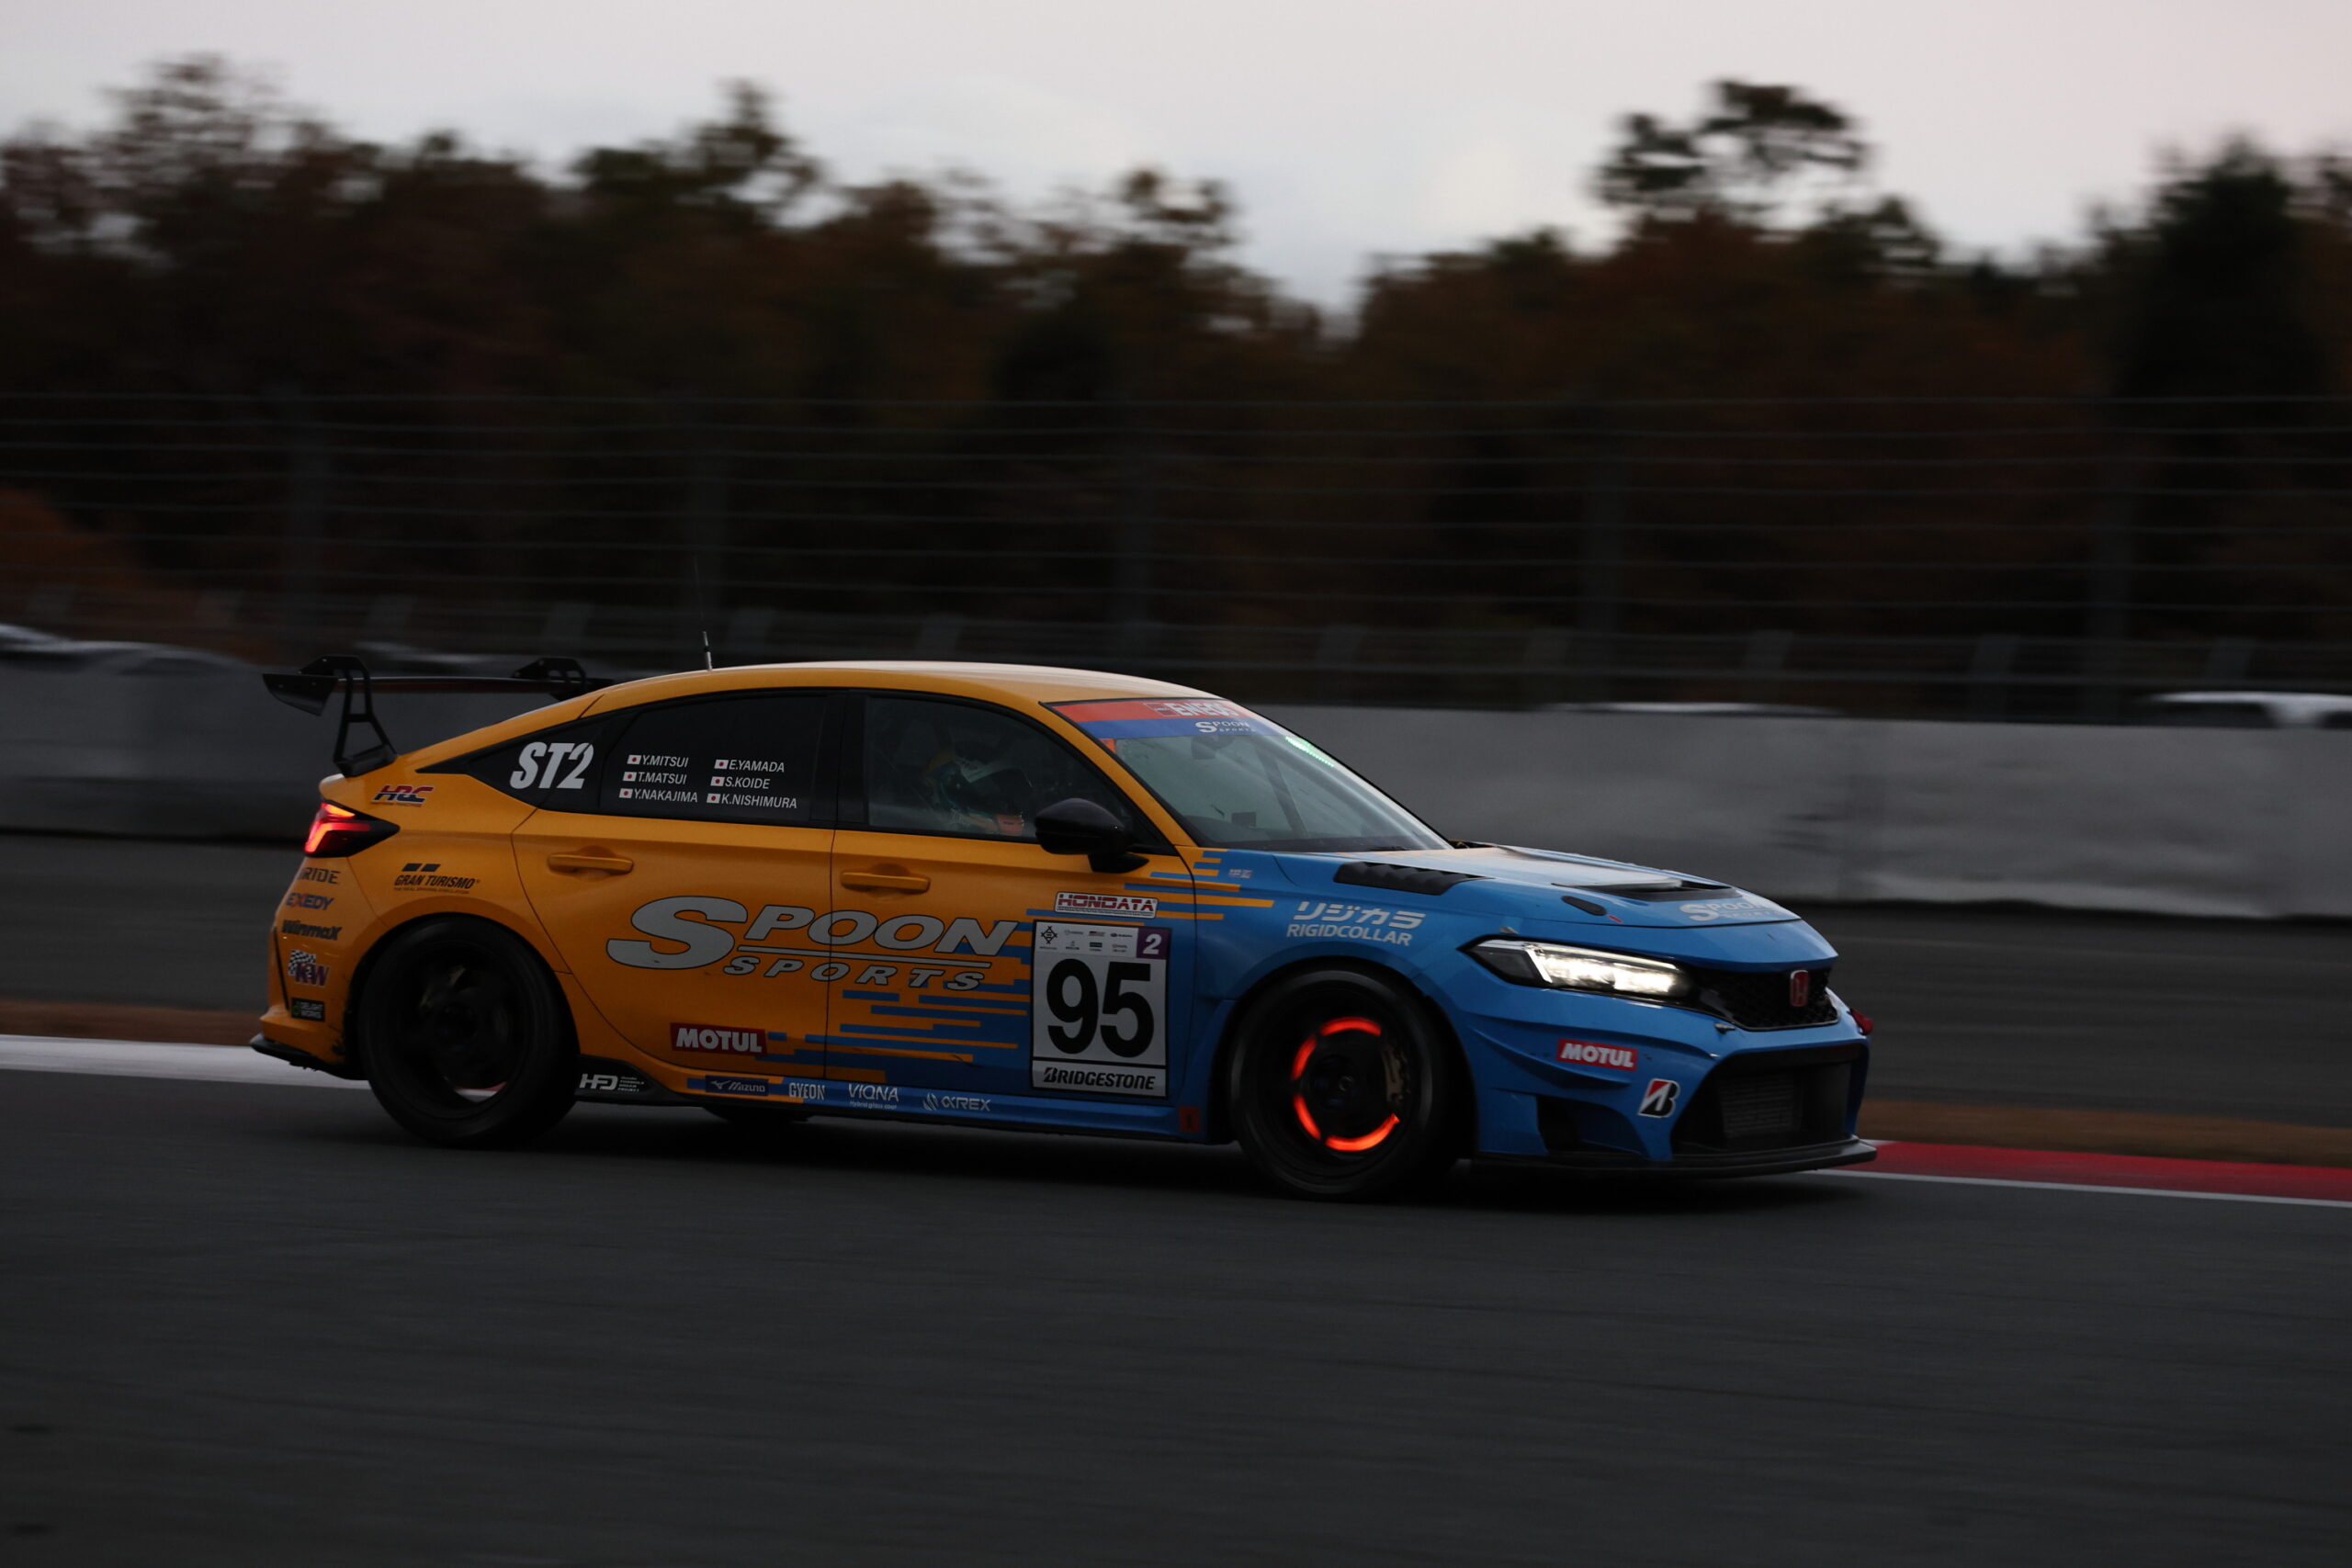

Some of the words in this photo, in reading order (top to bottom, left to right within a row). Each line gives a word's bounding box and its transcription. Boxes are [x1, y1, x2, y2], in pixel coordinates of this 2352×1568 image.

[1194, 721, 1250, 733] SPOON
[509, 741, 594, 790] ST2
[641, 754, 689, 769] Y.MITSUI
[729, 759, 785, 773] E.YAMADA
[638, 772, 687, 785] T.MATSUI
[725, 775, 770, 790] S.KOIDE
[372, 784, 435, 803] HRC
[633, 788, 698, 804] Y.NAKAJIMA
[720, 793, 797, 809] K.NISHIMURA
[393, 874, 425, 886] GRAN
[425, 874, 476, 889] TURISMO
[286, 892, 335, 910] EXEDY
[1057, 893, 1155, 912] HONDATA
[1293, 900, 1427, 930] リジカラ
[605, 895, 1020, 970] SPOON
[1286, 923, 1413, 947] RIGIDCOLLAR
[1142, 933, 1162, 955] 2
[723, 956, 986, 991] SPORTS
[1046, 958, 1155, 1058] 95
[675, 1027, 763, 1054] MOTUL
[1559, 1042, 1635, 1069] MOTUL
[1043, 1066, 1156, 1090] BRIDGESTONE
[788, 1082, 826, 1100] GYEON
